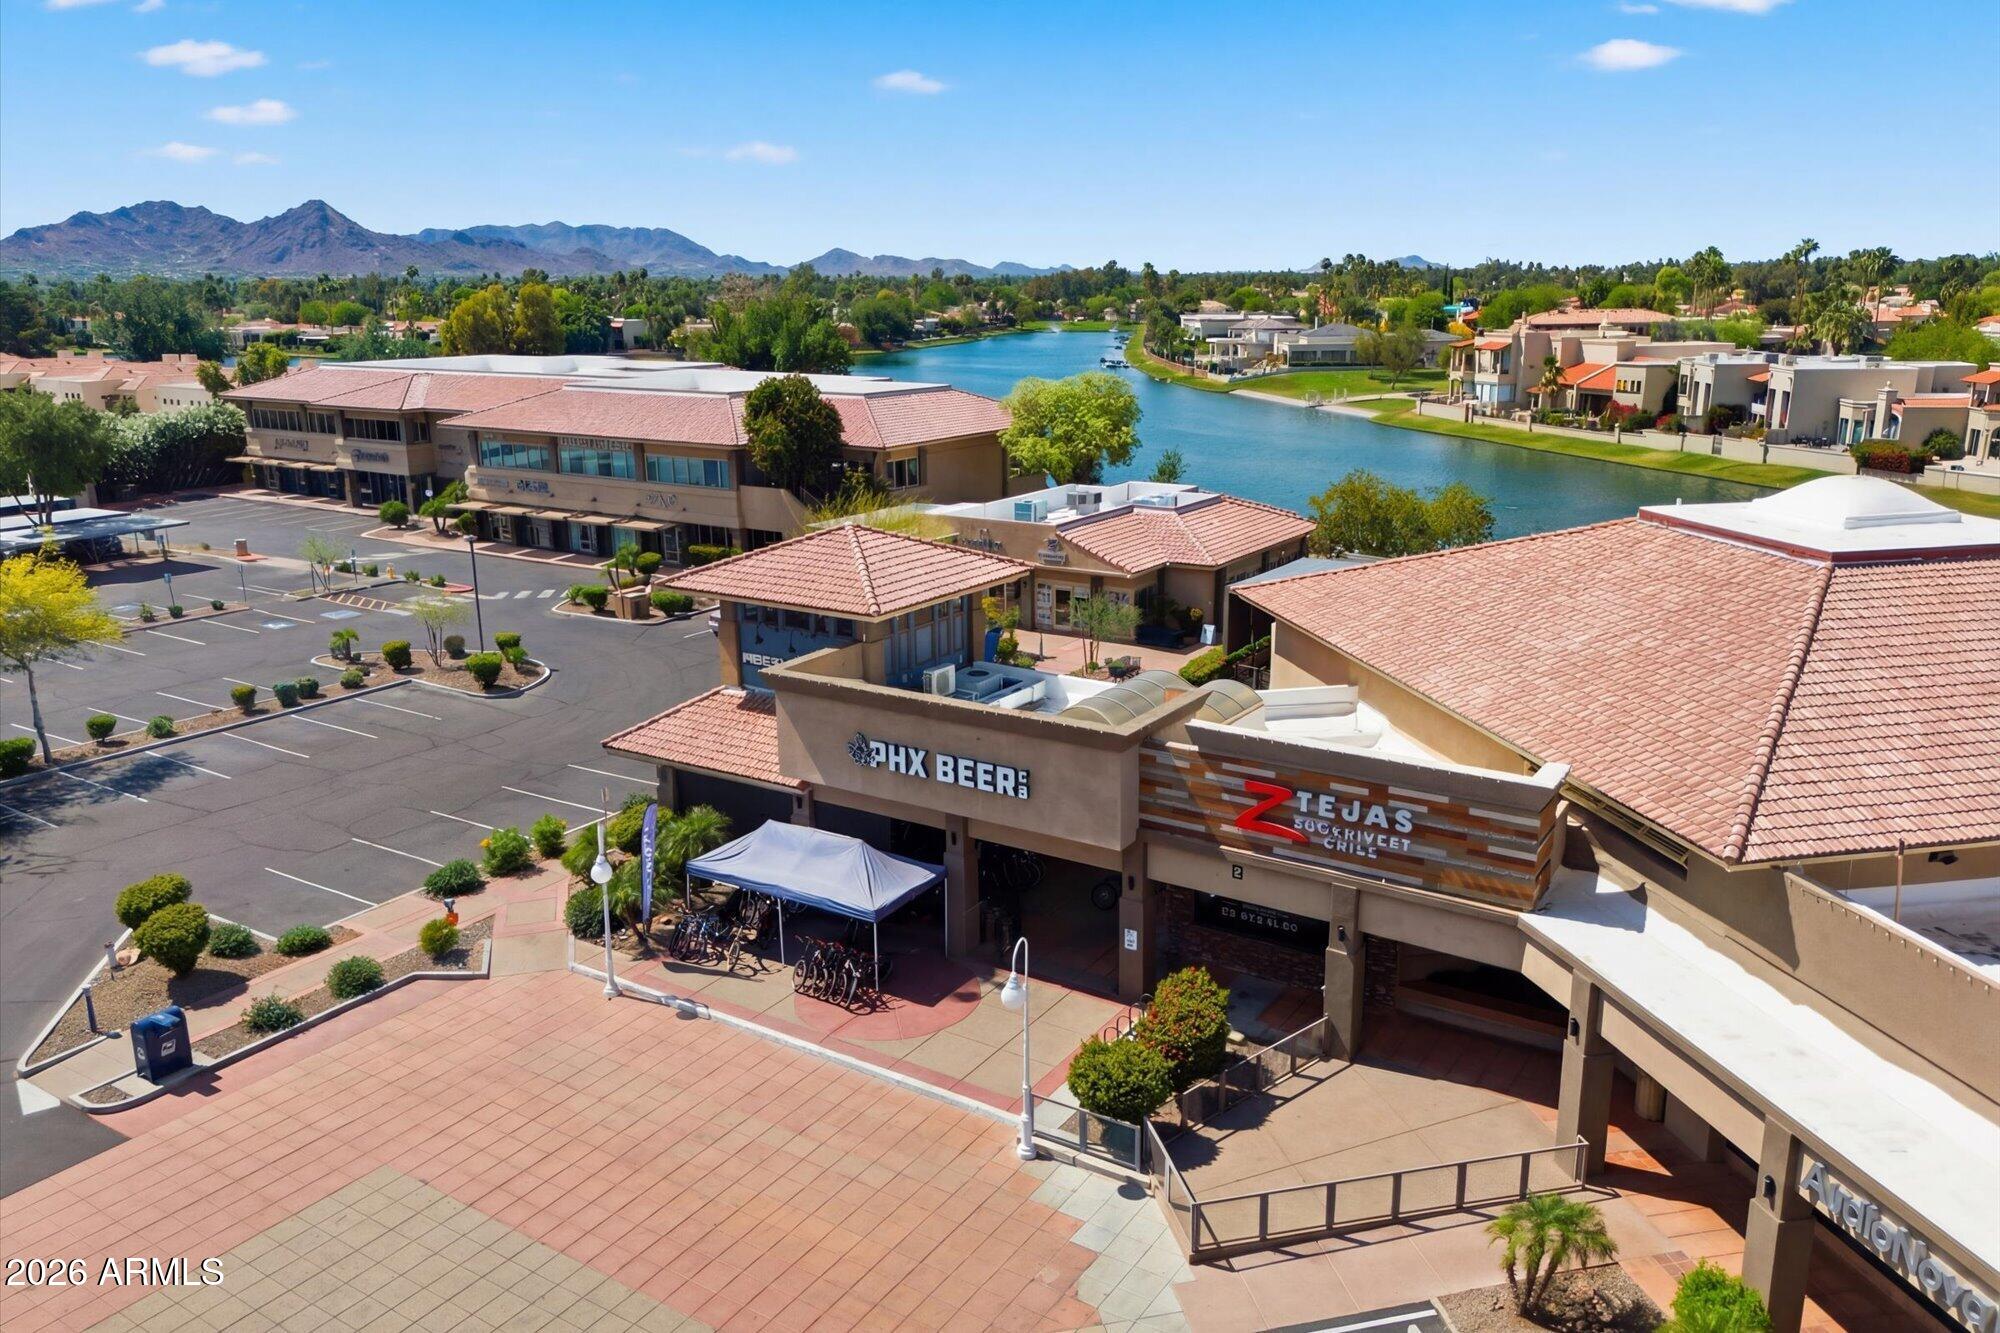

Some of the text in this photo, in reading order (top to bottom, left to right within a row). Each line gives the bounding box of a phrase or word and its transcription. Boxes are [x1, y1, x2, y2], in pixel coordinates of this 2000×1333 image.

[869, 740, 929, 778] PHX
[936, 753, 1016, 797] BEER
[1234, 779, 1413, 844] Z TEJAS
[1233, 866, 1242, 879] 2
[1799, 1161, 2000, 1333] AudioNova
